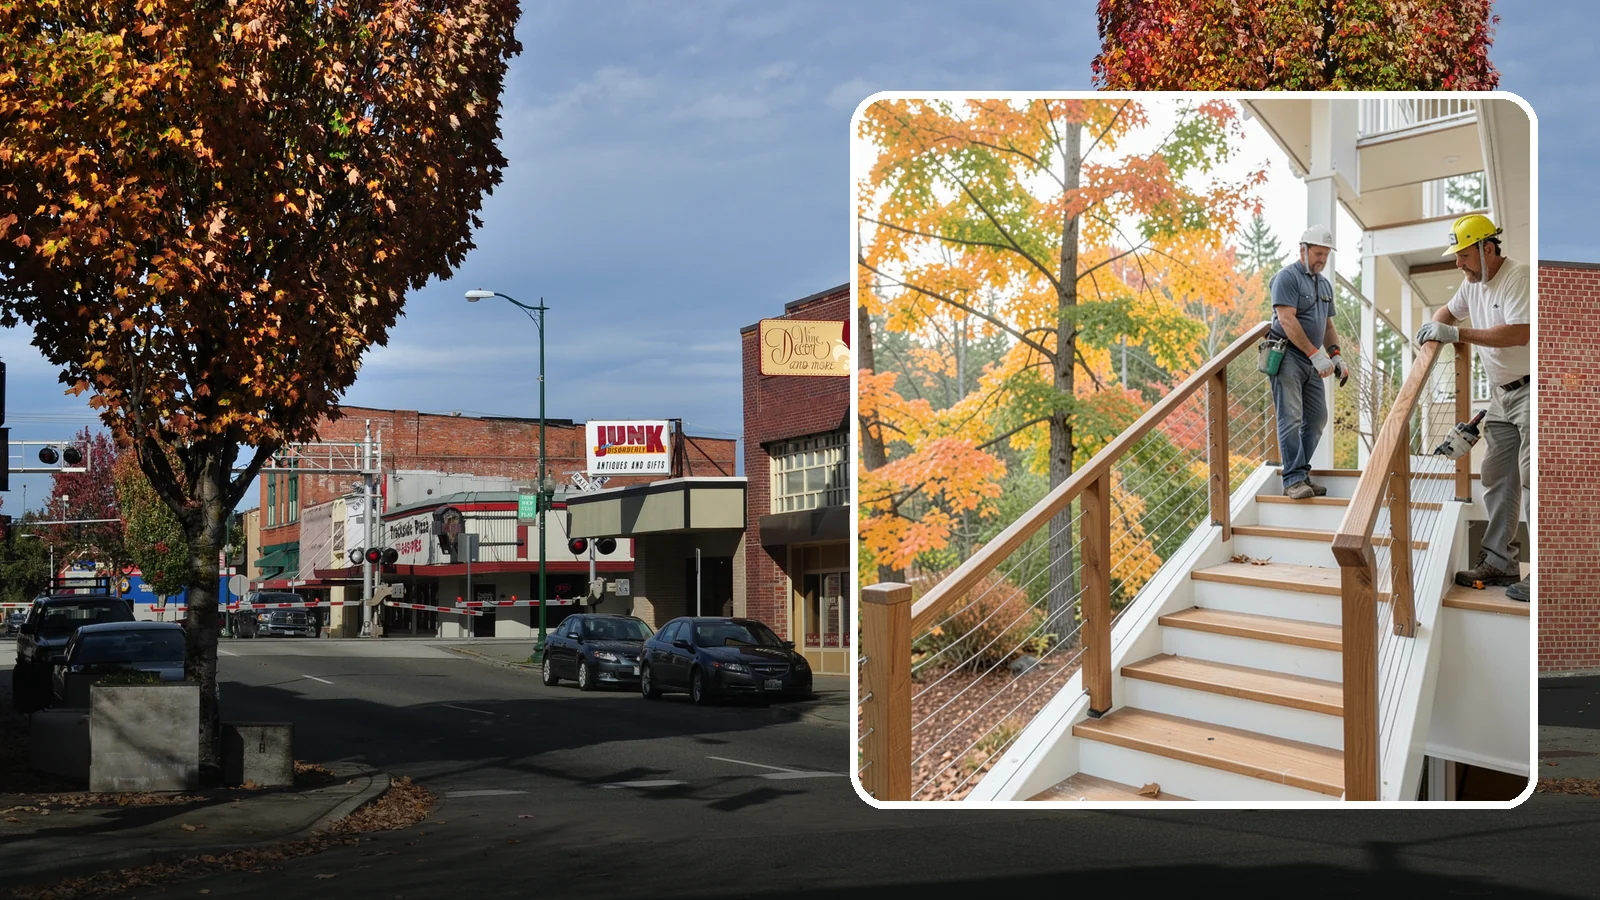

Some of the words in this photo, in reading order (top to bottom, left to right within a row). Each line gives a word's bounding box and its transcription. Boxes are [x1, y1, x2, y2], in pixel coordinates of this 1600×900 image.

[765, 327, 831, 365] Decor
[595, 425, 664, 457] JUNK
[607, 446, 646, 454] DISORDERLY
[597, 461, 628, 470] ANTIQUES
[631, 461, 644, 470] AND
[647, 460, 665, 469] GIFTS
[415, 520, 429, 534] Pizza
